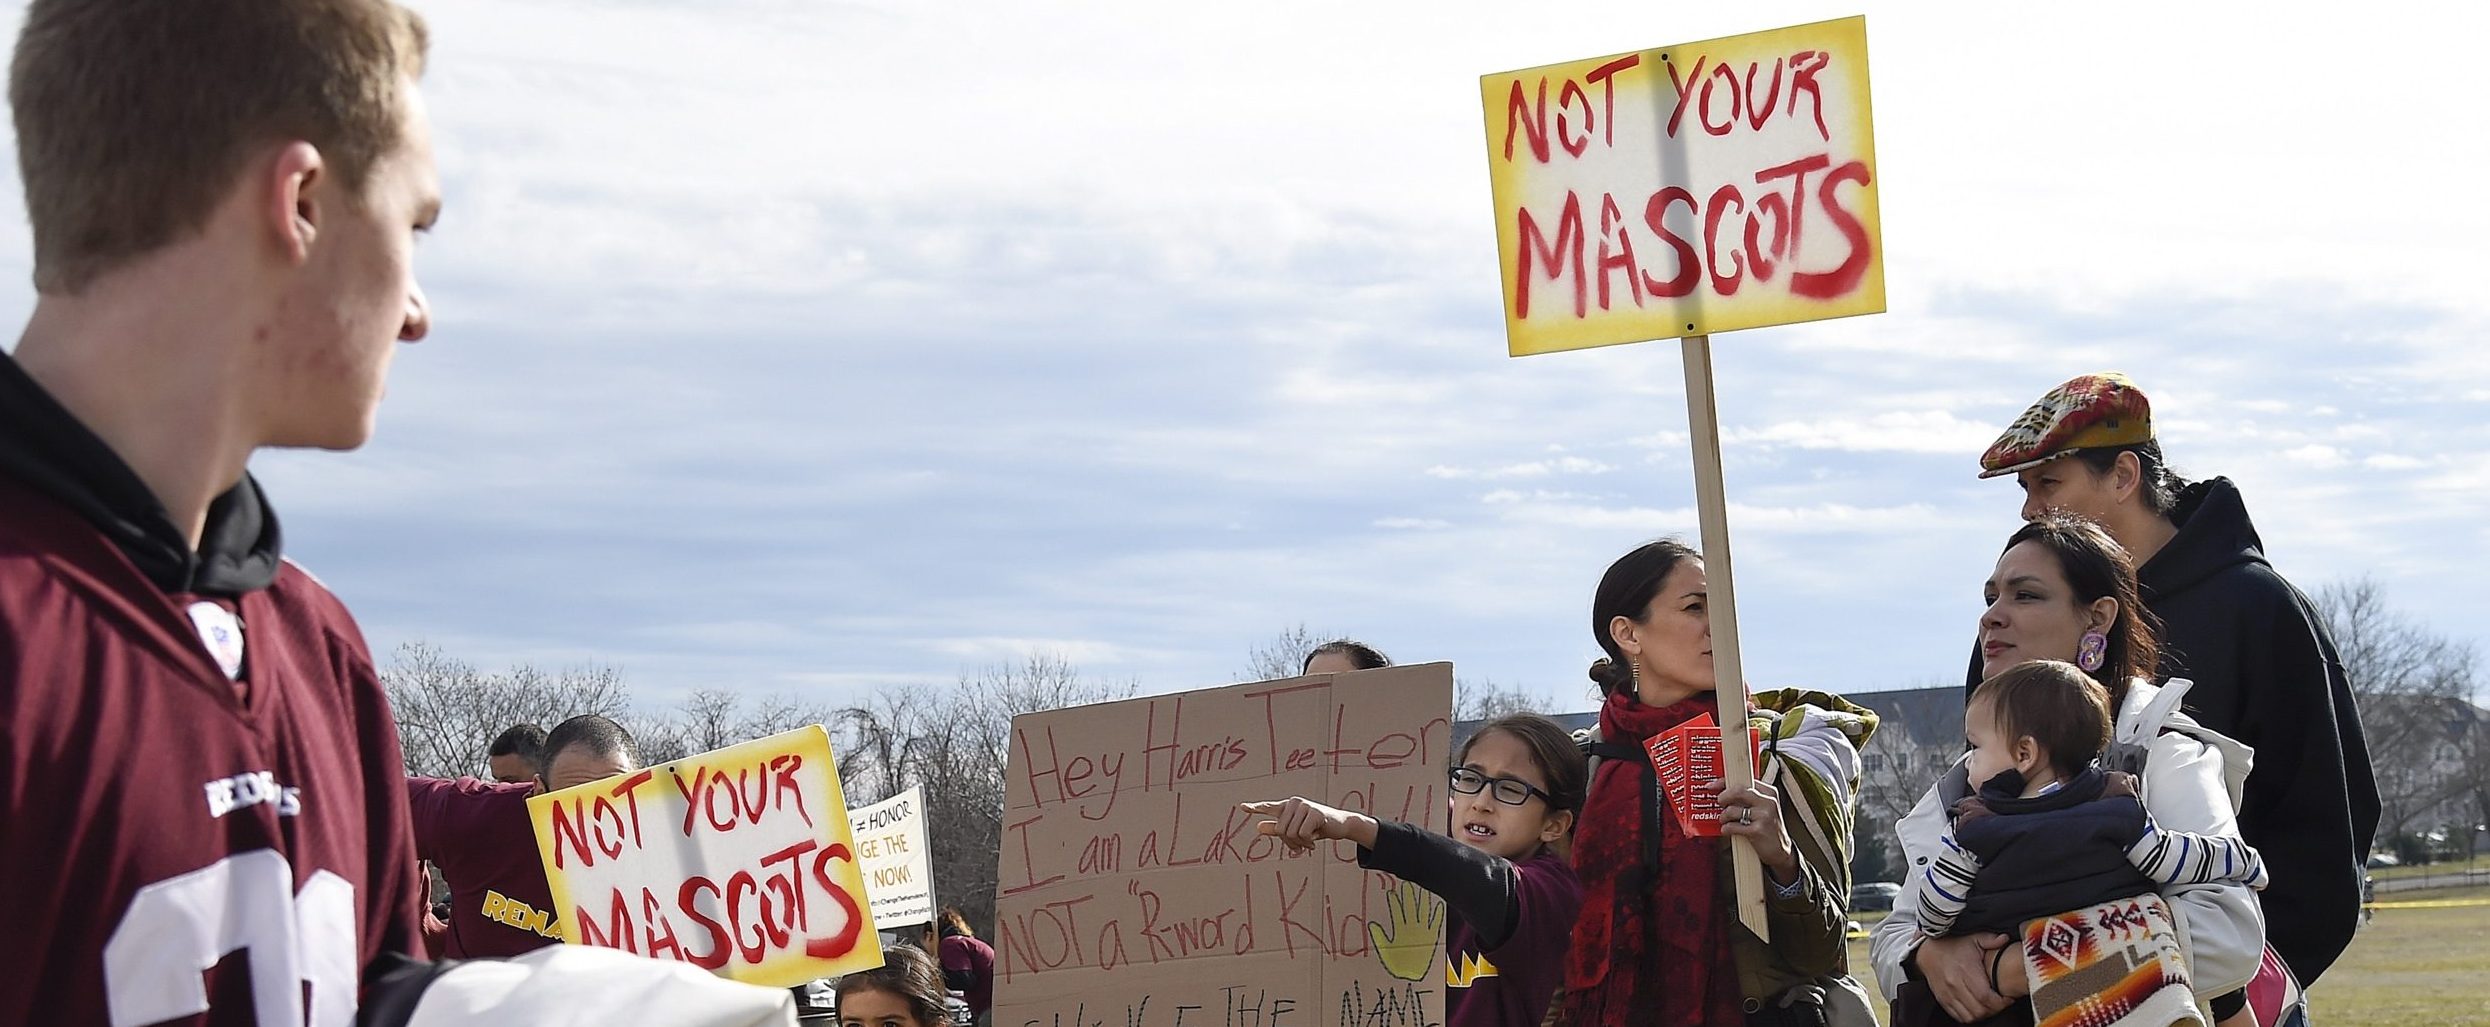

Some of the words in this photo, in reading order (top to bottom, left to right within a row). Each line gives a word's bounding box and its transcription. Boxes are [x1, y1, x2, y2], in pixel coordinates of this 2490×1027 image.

[1505, 55, 1640, 163] NOT
[1666, 50, 1830, 141] YOUR
[1515, 153, 1872, 321] MASCOTS
[1018, 725, 1124, 821] Hey
[1142, 697, 1247, 792] Harris
[553, 772, 653, 870] NOT
[673, 753, 813, 837] YOUR
[869, 801, 912, 830] HONOR
[883, 833, 909, 855] THE
[1003, 814, 1066, 894] I
[1078, 833, 1121, 874] am
[1138, 830, 1160, 868] a
[575, 839, 864, 971] MASCOTS
[873, 864, 913, 889] NOW!
[999, 894, 1094, 985] NOT
[1098, 919, 1129, 971] a
[1219, 984, 1297, 1027] THE
[1339, 979, 1440, 1027] NAME
